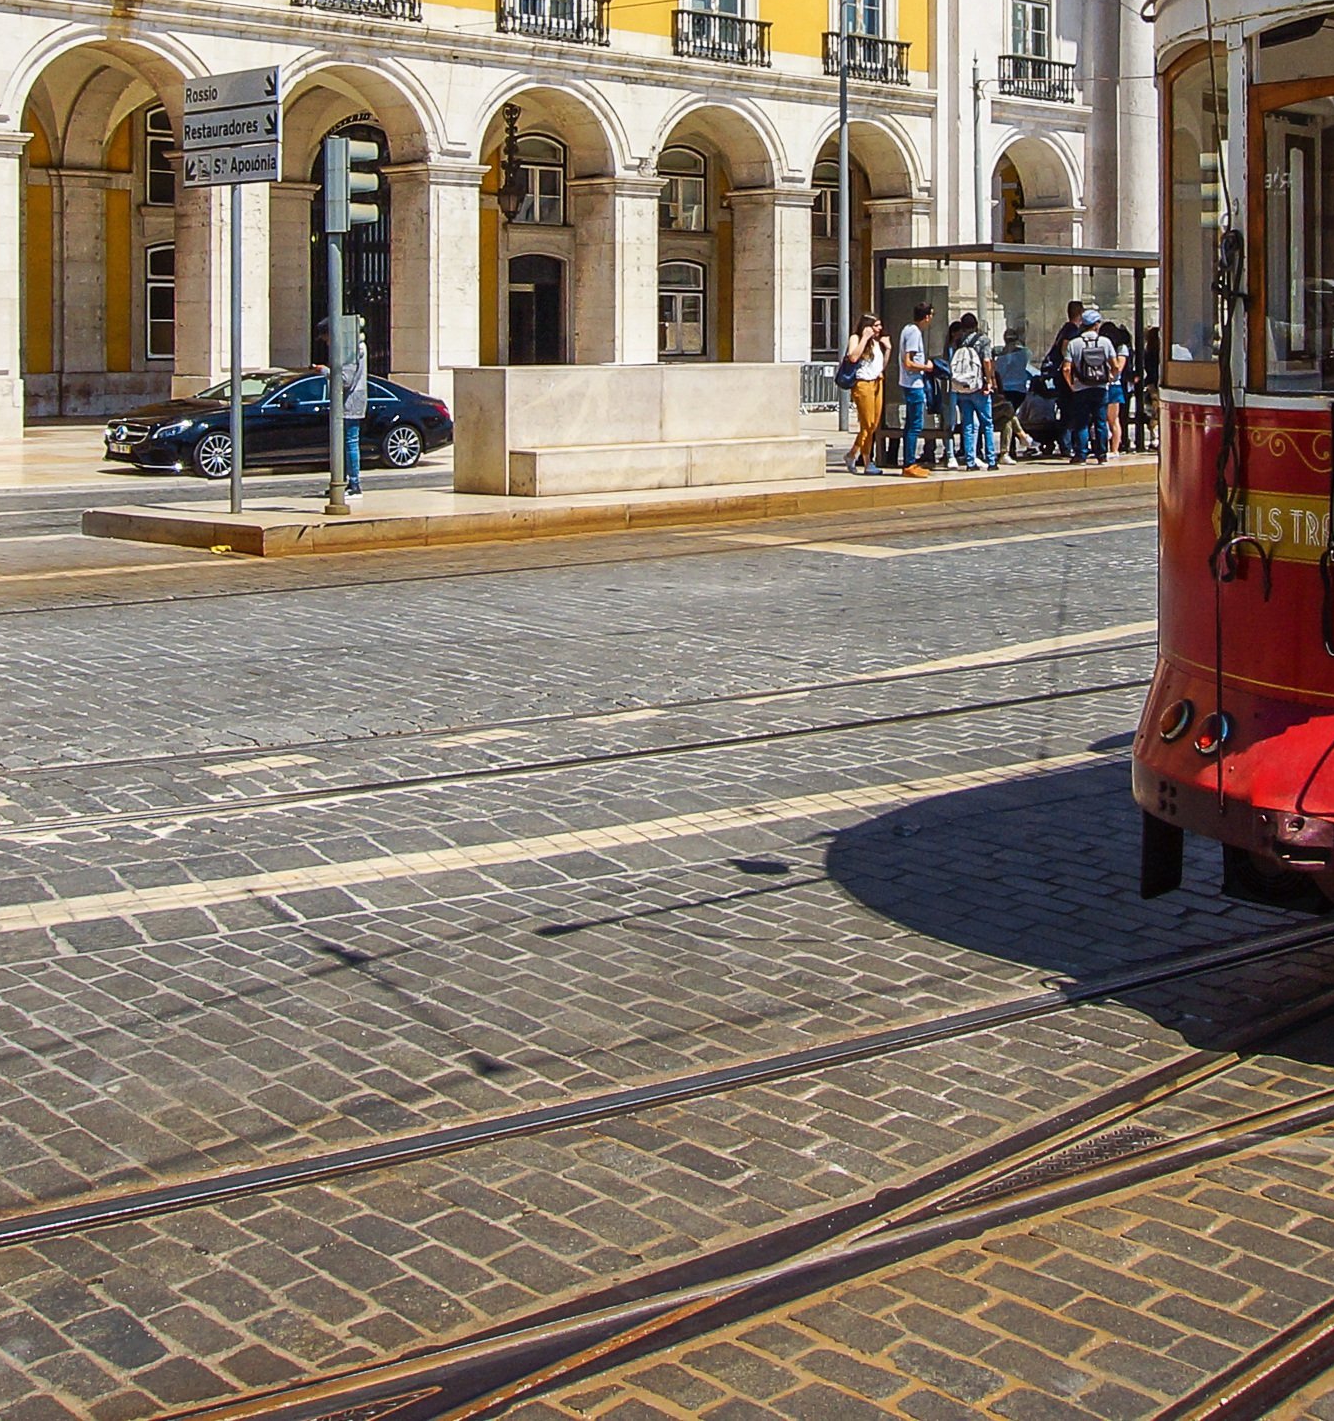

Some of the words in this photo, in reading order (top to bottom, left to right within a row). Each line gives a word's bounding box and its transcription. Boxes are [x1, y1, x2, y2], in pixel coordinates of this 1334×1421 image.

[185, 85, 218, 104] Rossio
[184, 119, 259, 141] Restauradores
[230, 153, 277, 176] Apolónia
[1234, 504, 1284, 543] ILLS
